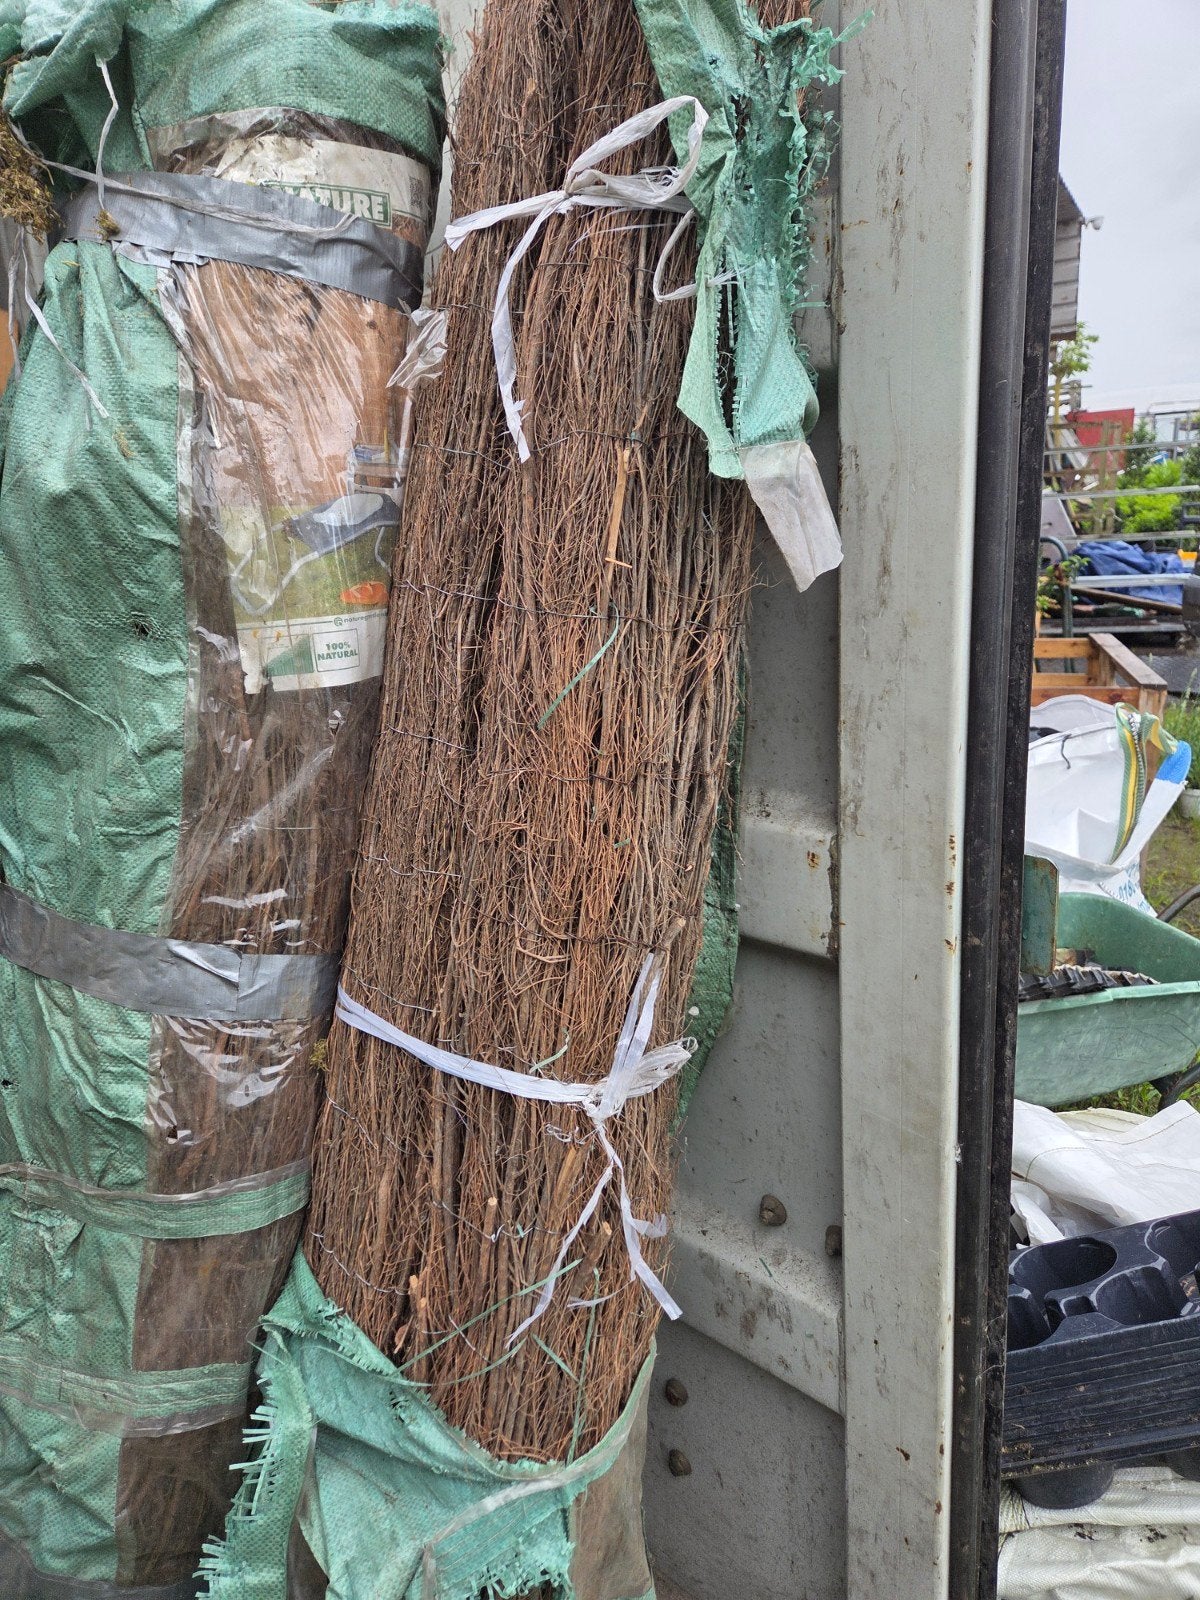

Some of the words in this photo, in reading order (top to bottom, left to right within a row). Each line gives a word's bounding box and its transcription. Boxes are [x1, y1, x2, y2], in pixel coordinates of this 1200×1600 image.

[284, 186, 384, 221] ATURE
[325, 641, 351, 650] 100%
[317, 649, 358, 661] NATURAL
